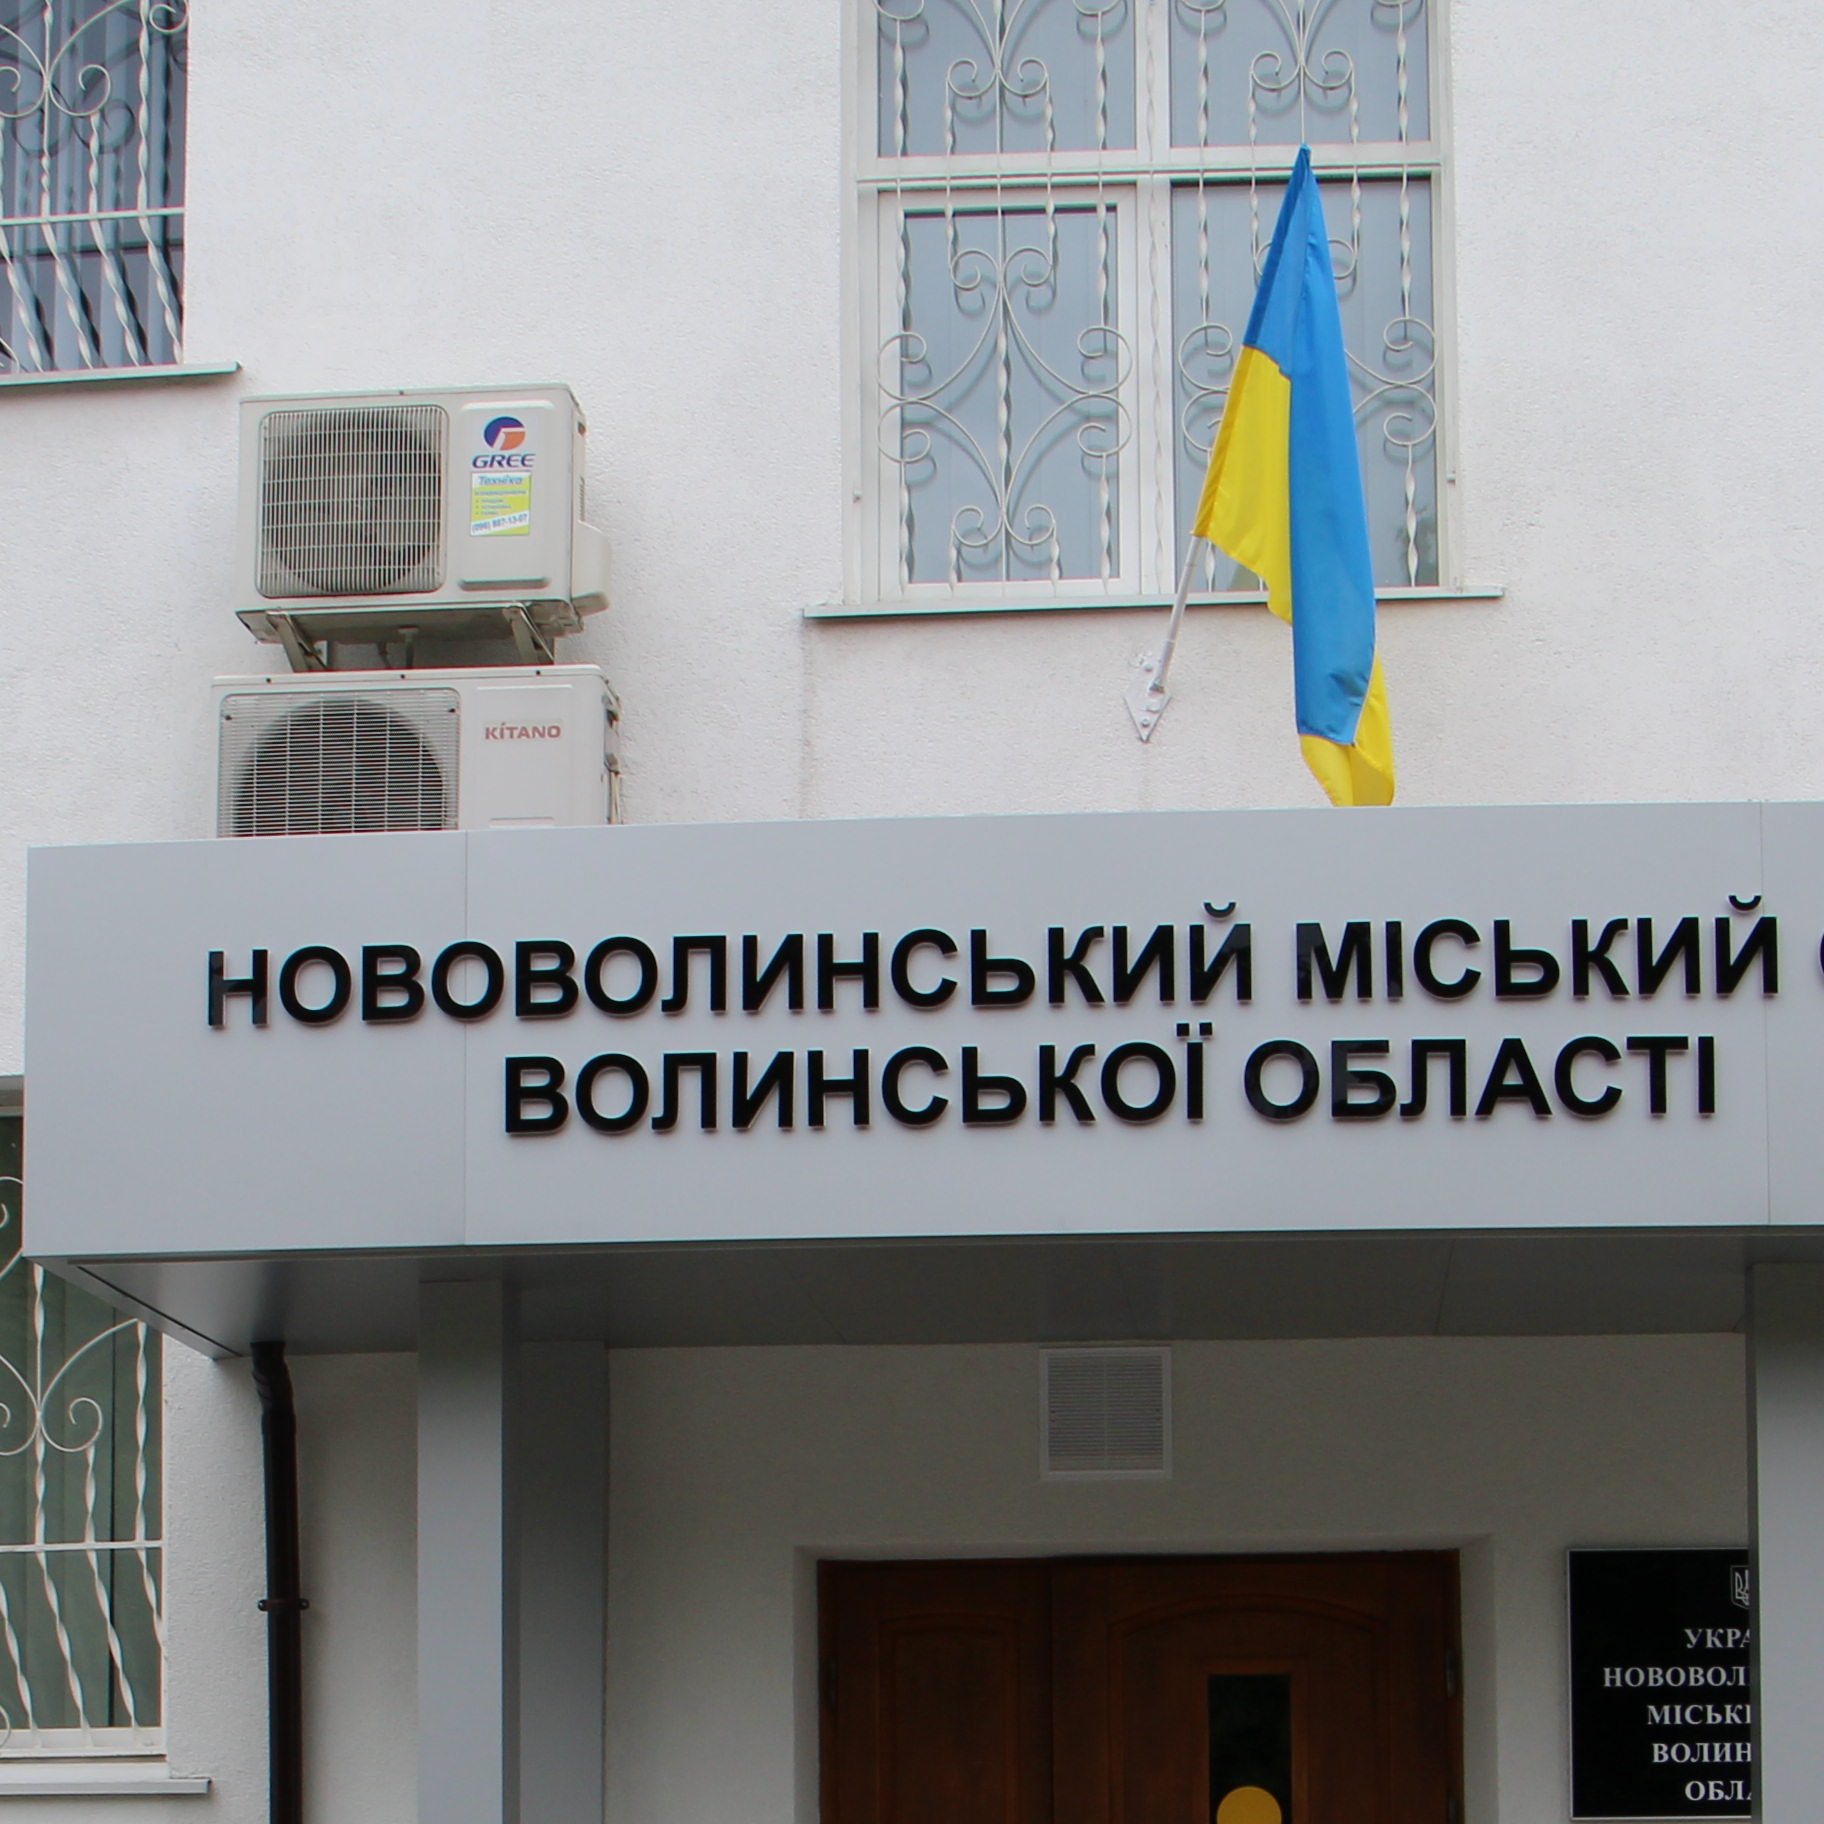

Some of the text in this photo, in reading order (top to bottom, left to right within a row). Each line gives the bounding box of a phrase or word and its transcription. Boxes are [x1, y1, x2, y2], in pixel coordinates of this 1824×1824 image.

[472, 453, 536, 469] GREE
[207, 902, 1252, 1031] НОВОВОЛИНСЬКИЙ
[1296, 895, 1780, 1005] МІСЬКИЙ
[505, 1022, 1717, 1139] ВОЛИНСЬКОЇ ОБЛАСТІ
[1684, 1628, 1751, 1649] УКРА
[1647, 1704, 1751, 1726] МІСЬК
